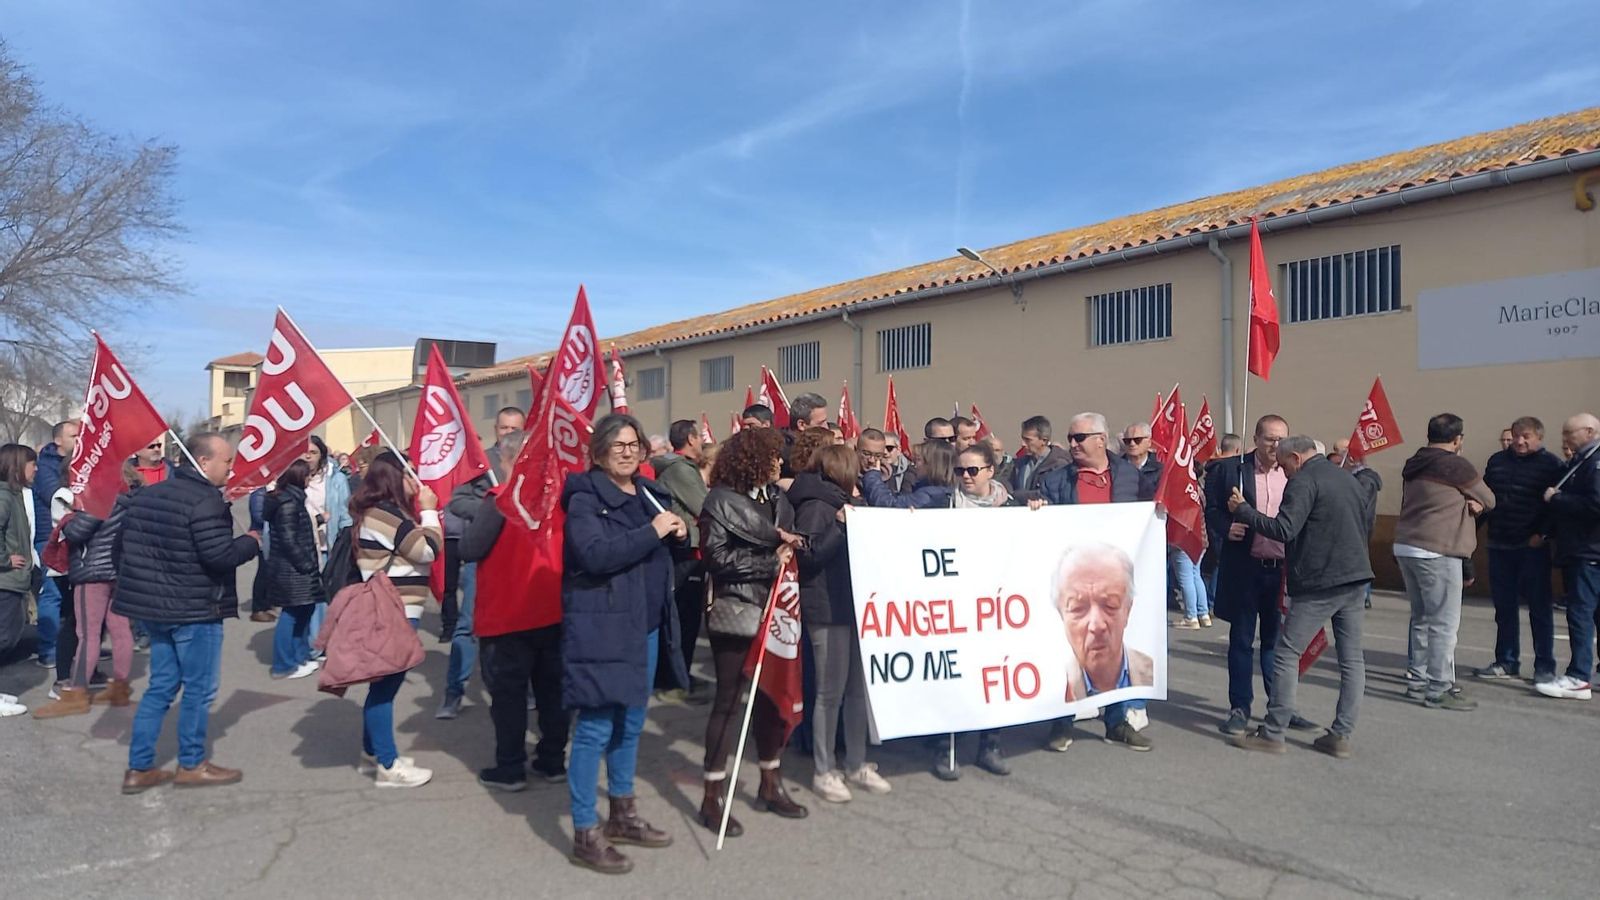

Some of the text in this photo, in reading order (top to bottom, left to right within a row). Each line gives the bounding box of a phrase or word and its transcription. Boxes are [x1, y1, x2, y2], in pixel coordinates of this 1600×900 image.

[1498, 297, 1600, 324] MarieCla
[1548, 325, 1579, 335] 1907
[921, 548, 959, 577] DE
[860, 587, 1030, 639] ÁNGEL PÍO
[870, 650, 1041, 704] NO ME FÍO
